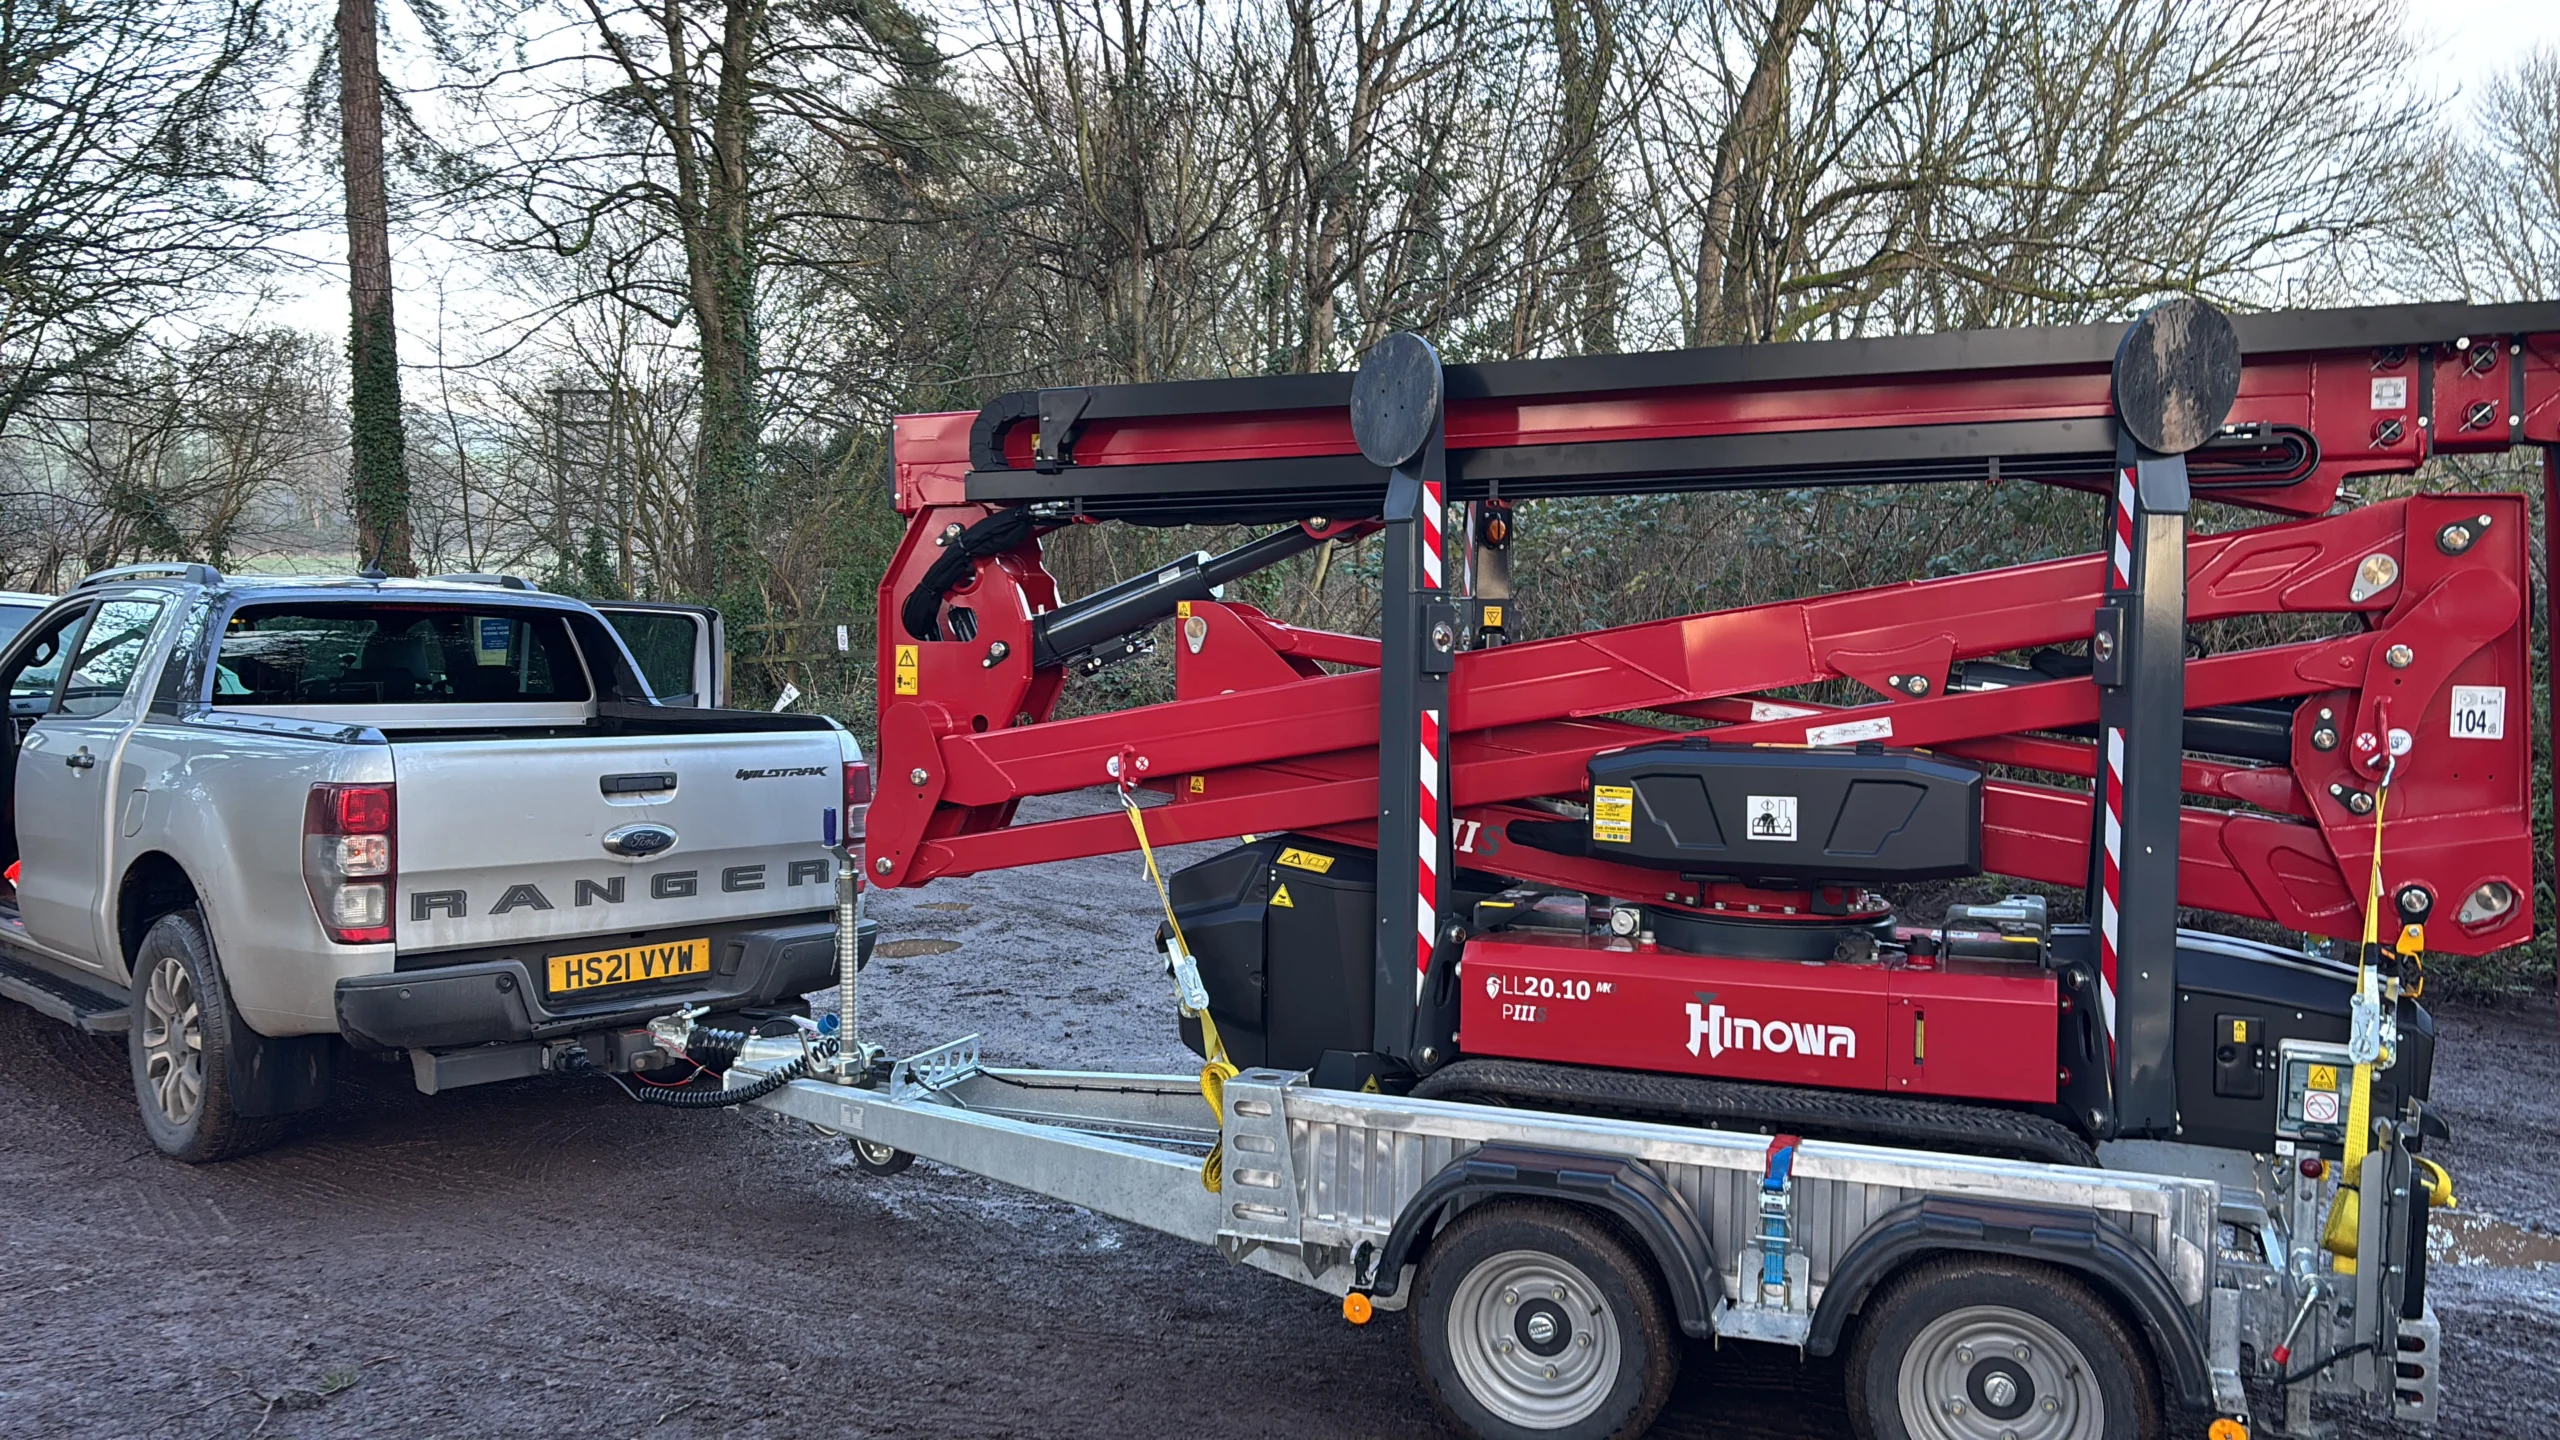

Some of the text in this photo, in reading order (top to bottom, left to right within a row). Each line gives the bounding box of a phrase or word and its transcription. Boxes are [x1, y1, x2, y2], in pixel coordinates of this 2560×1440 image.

[2456, 708, 2486, 734] 104
[735, 766, 828, 780] WILDTRAK
[630, 832, 660, 848] Ford
[411, 859, 830, 921] RANGER
[564, 944, 693, 989] HS21 VYW
[1502, 974, 1591, 1001] LL20.10
